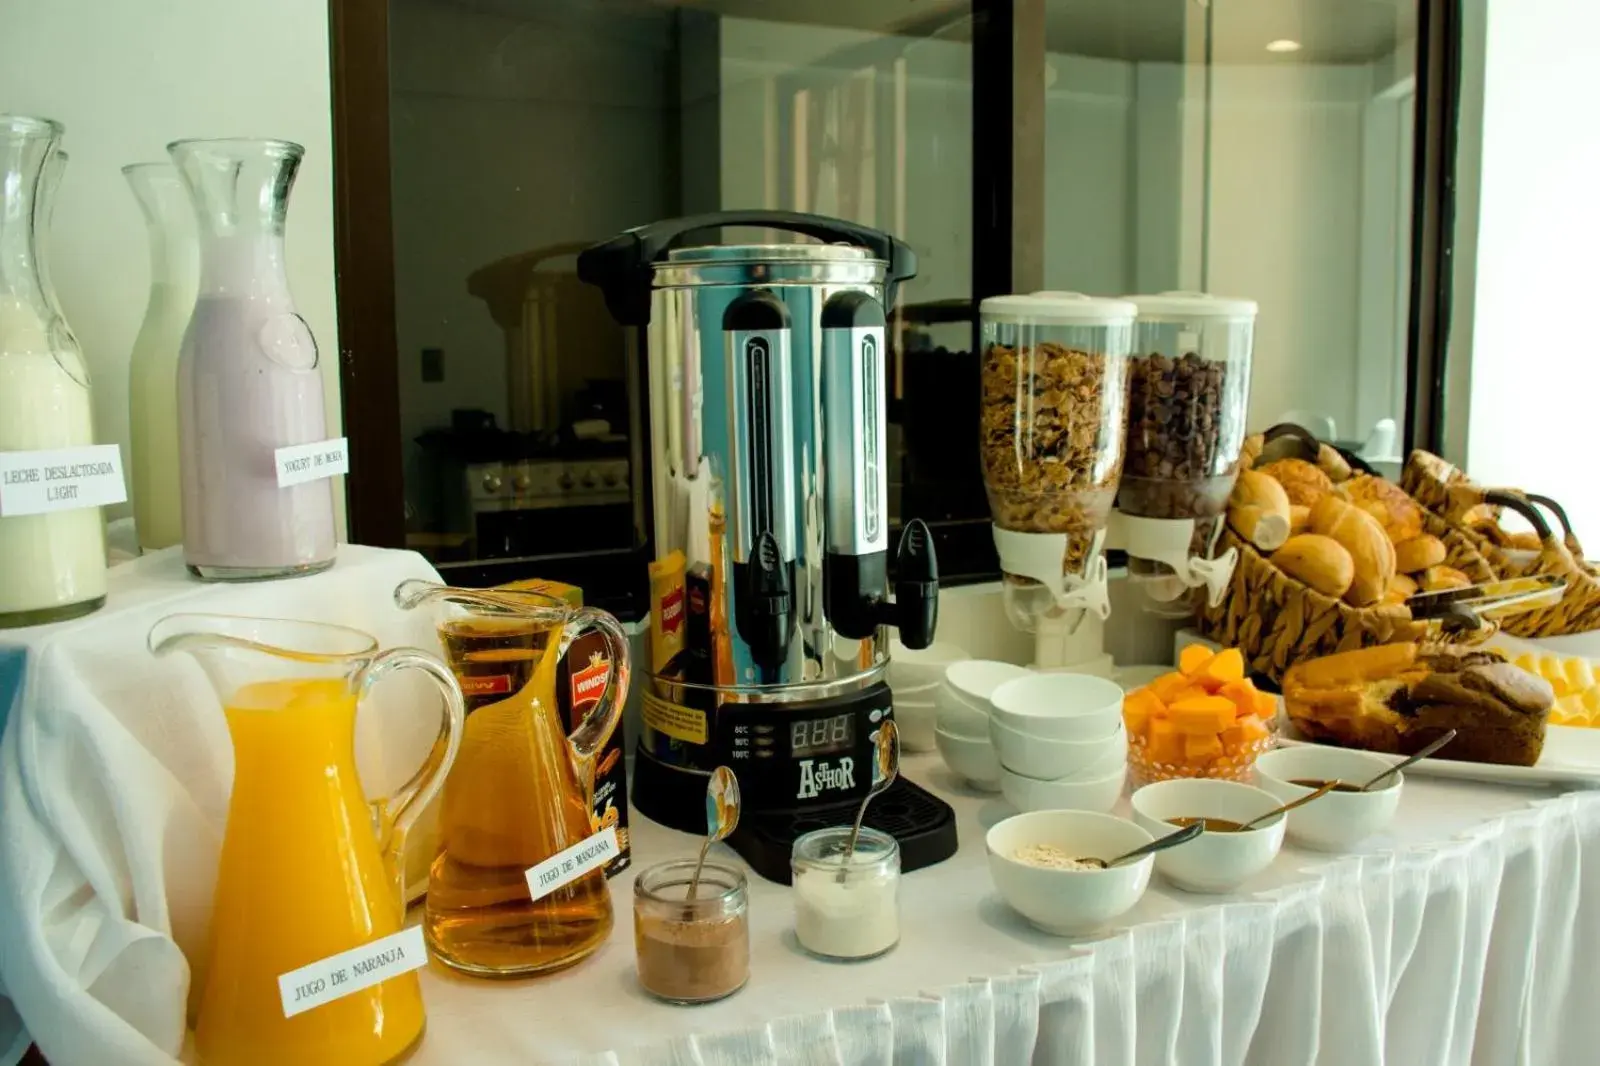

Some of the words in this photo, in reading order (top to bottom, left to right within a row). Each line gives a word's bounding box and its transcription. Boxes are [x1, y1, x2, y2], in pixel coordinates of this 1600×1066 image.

[4, 467, 40, 485] LECHE
[43, 461, 115, 481] DESLACTOSADA
[46, 484, 79, 502] LIGHT
[796, 756, 856, 799] ASTHOR
[540, 867, 560, 888] JUGO
[560, 859, 575, 874] DE
[575, 839, 610, 867] MANZANA
[294, 978, 326, 1002] JUGO
[330, 969, 349, 987] DE
[352, 946, 405, 977] NARANJA
